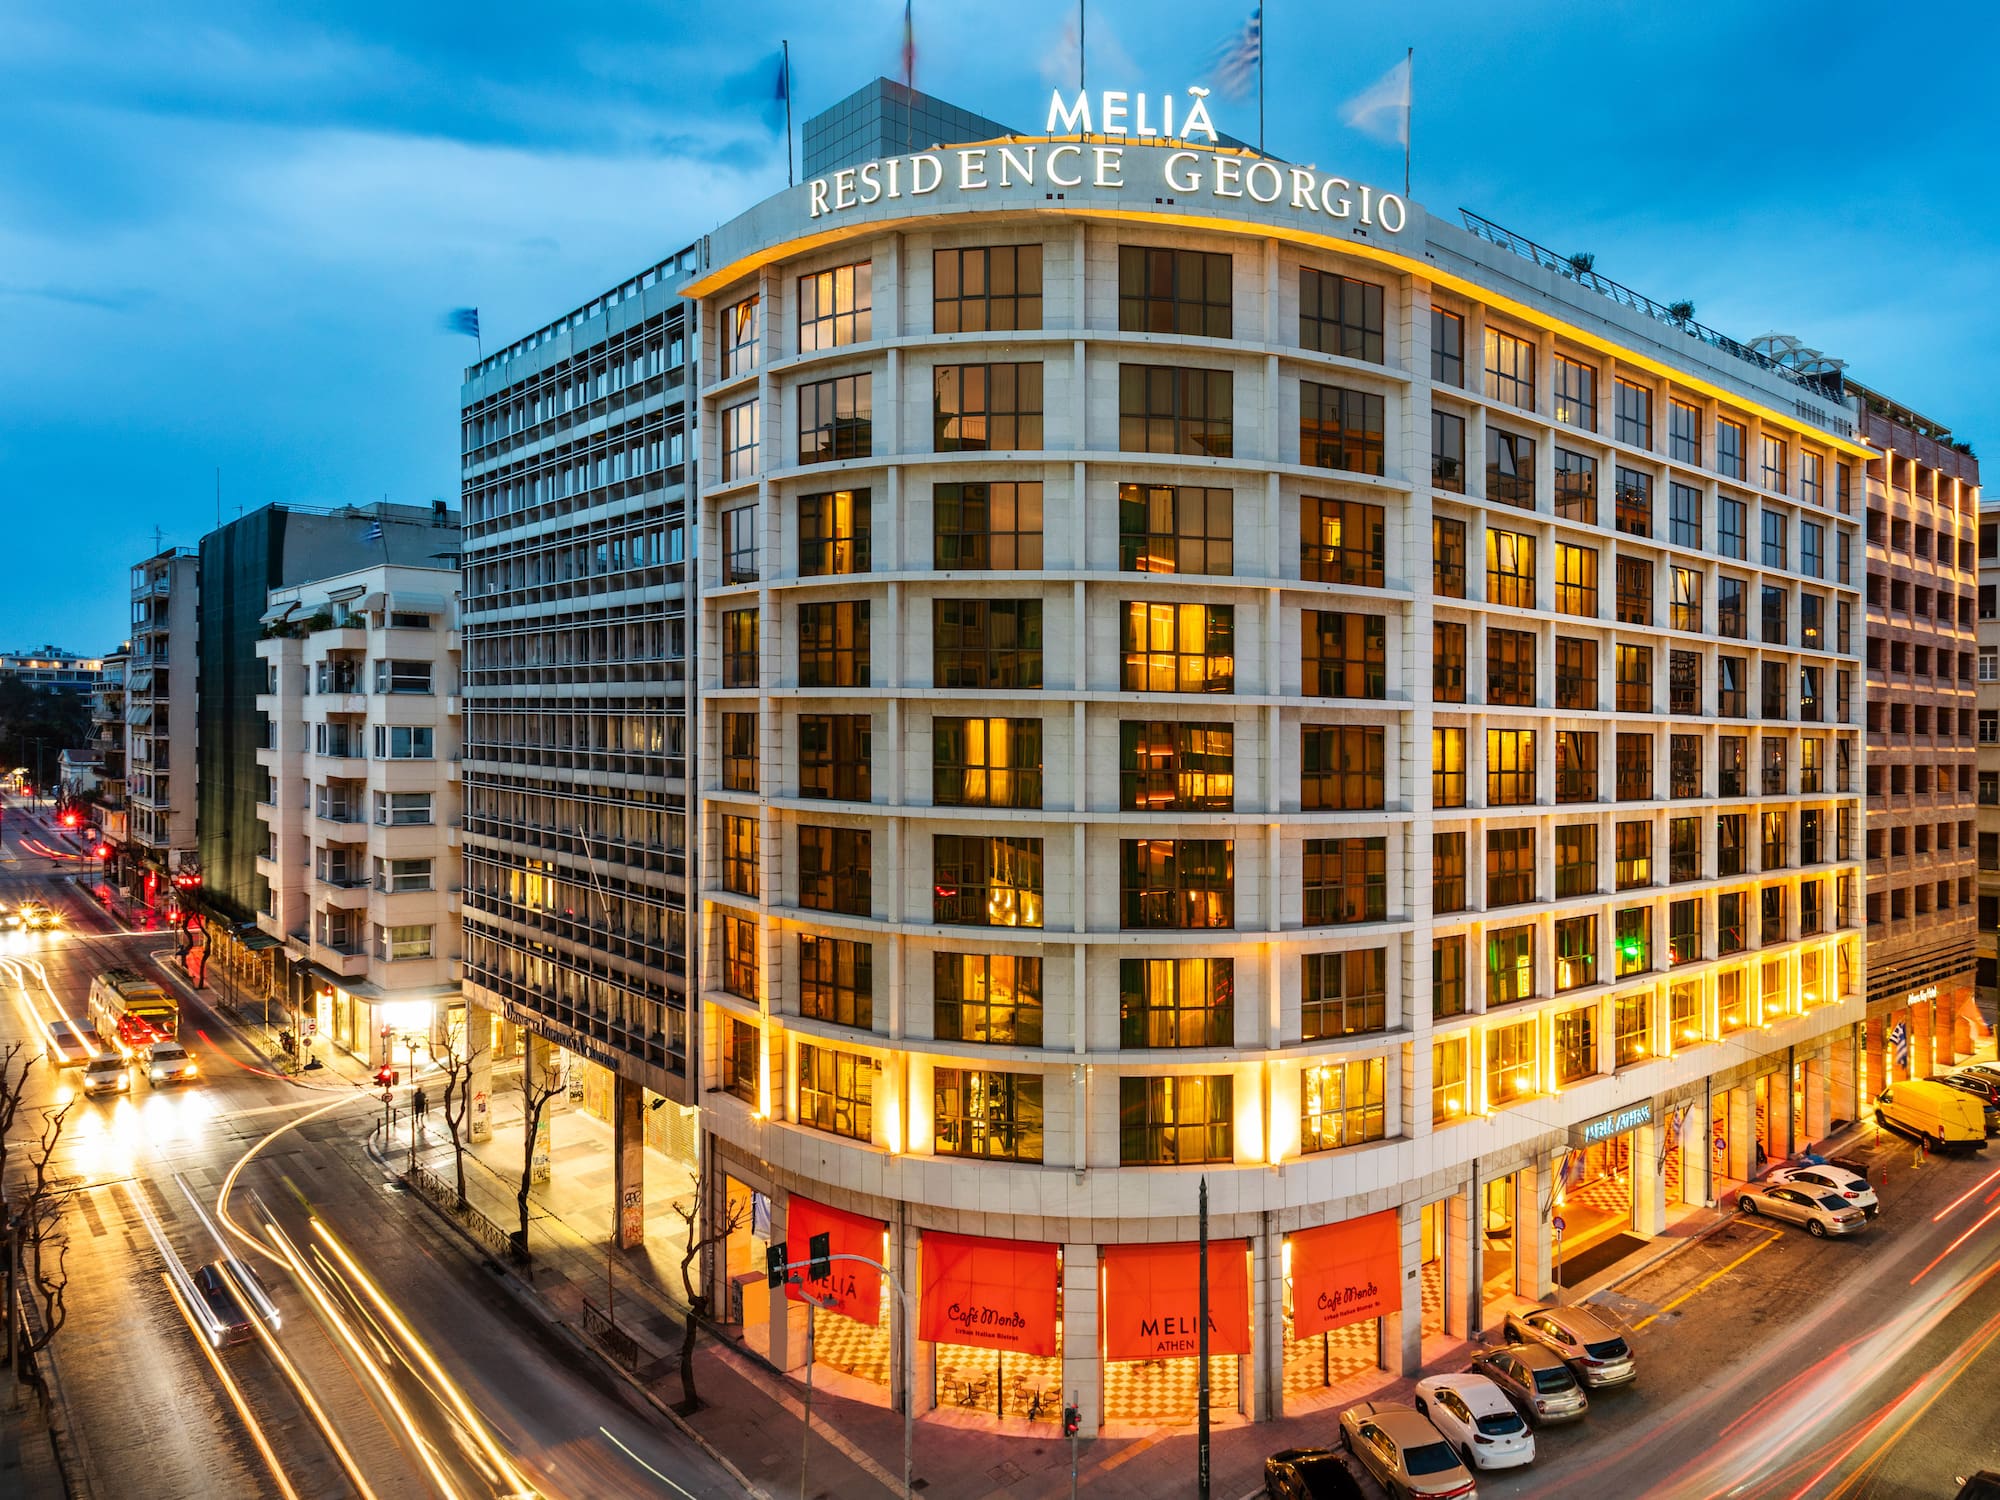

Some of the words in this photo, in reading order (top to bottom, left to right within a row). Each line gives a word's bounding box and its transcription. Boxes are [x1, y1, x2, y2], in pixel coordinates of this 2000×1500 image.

[809, 144, 1125, 218] RESIDENCE
[1164, 152, 1407, 233] GEORGIO
[1318, 1291, 1341, 1311] Café
[1344, 1282, 1377, 1303] Mondo
[948, 1303, 979, 1327] Café
[980, 1306, 1026, 1328] Mondo
[1157, 1340, 1194, 1351] ATHEN
